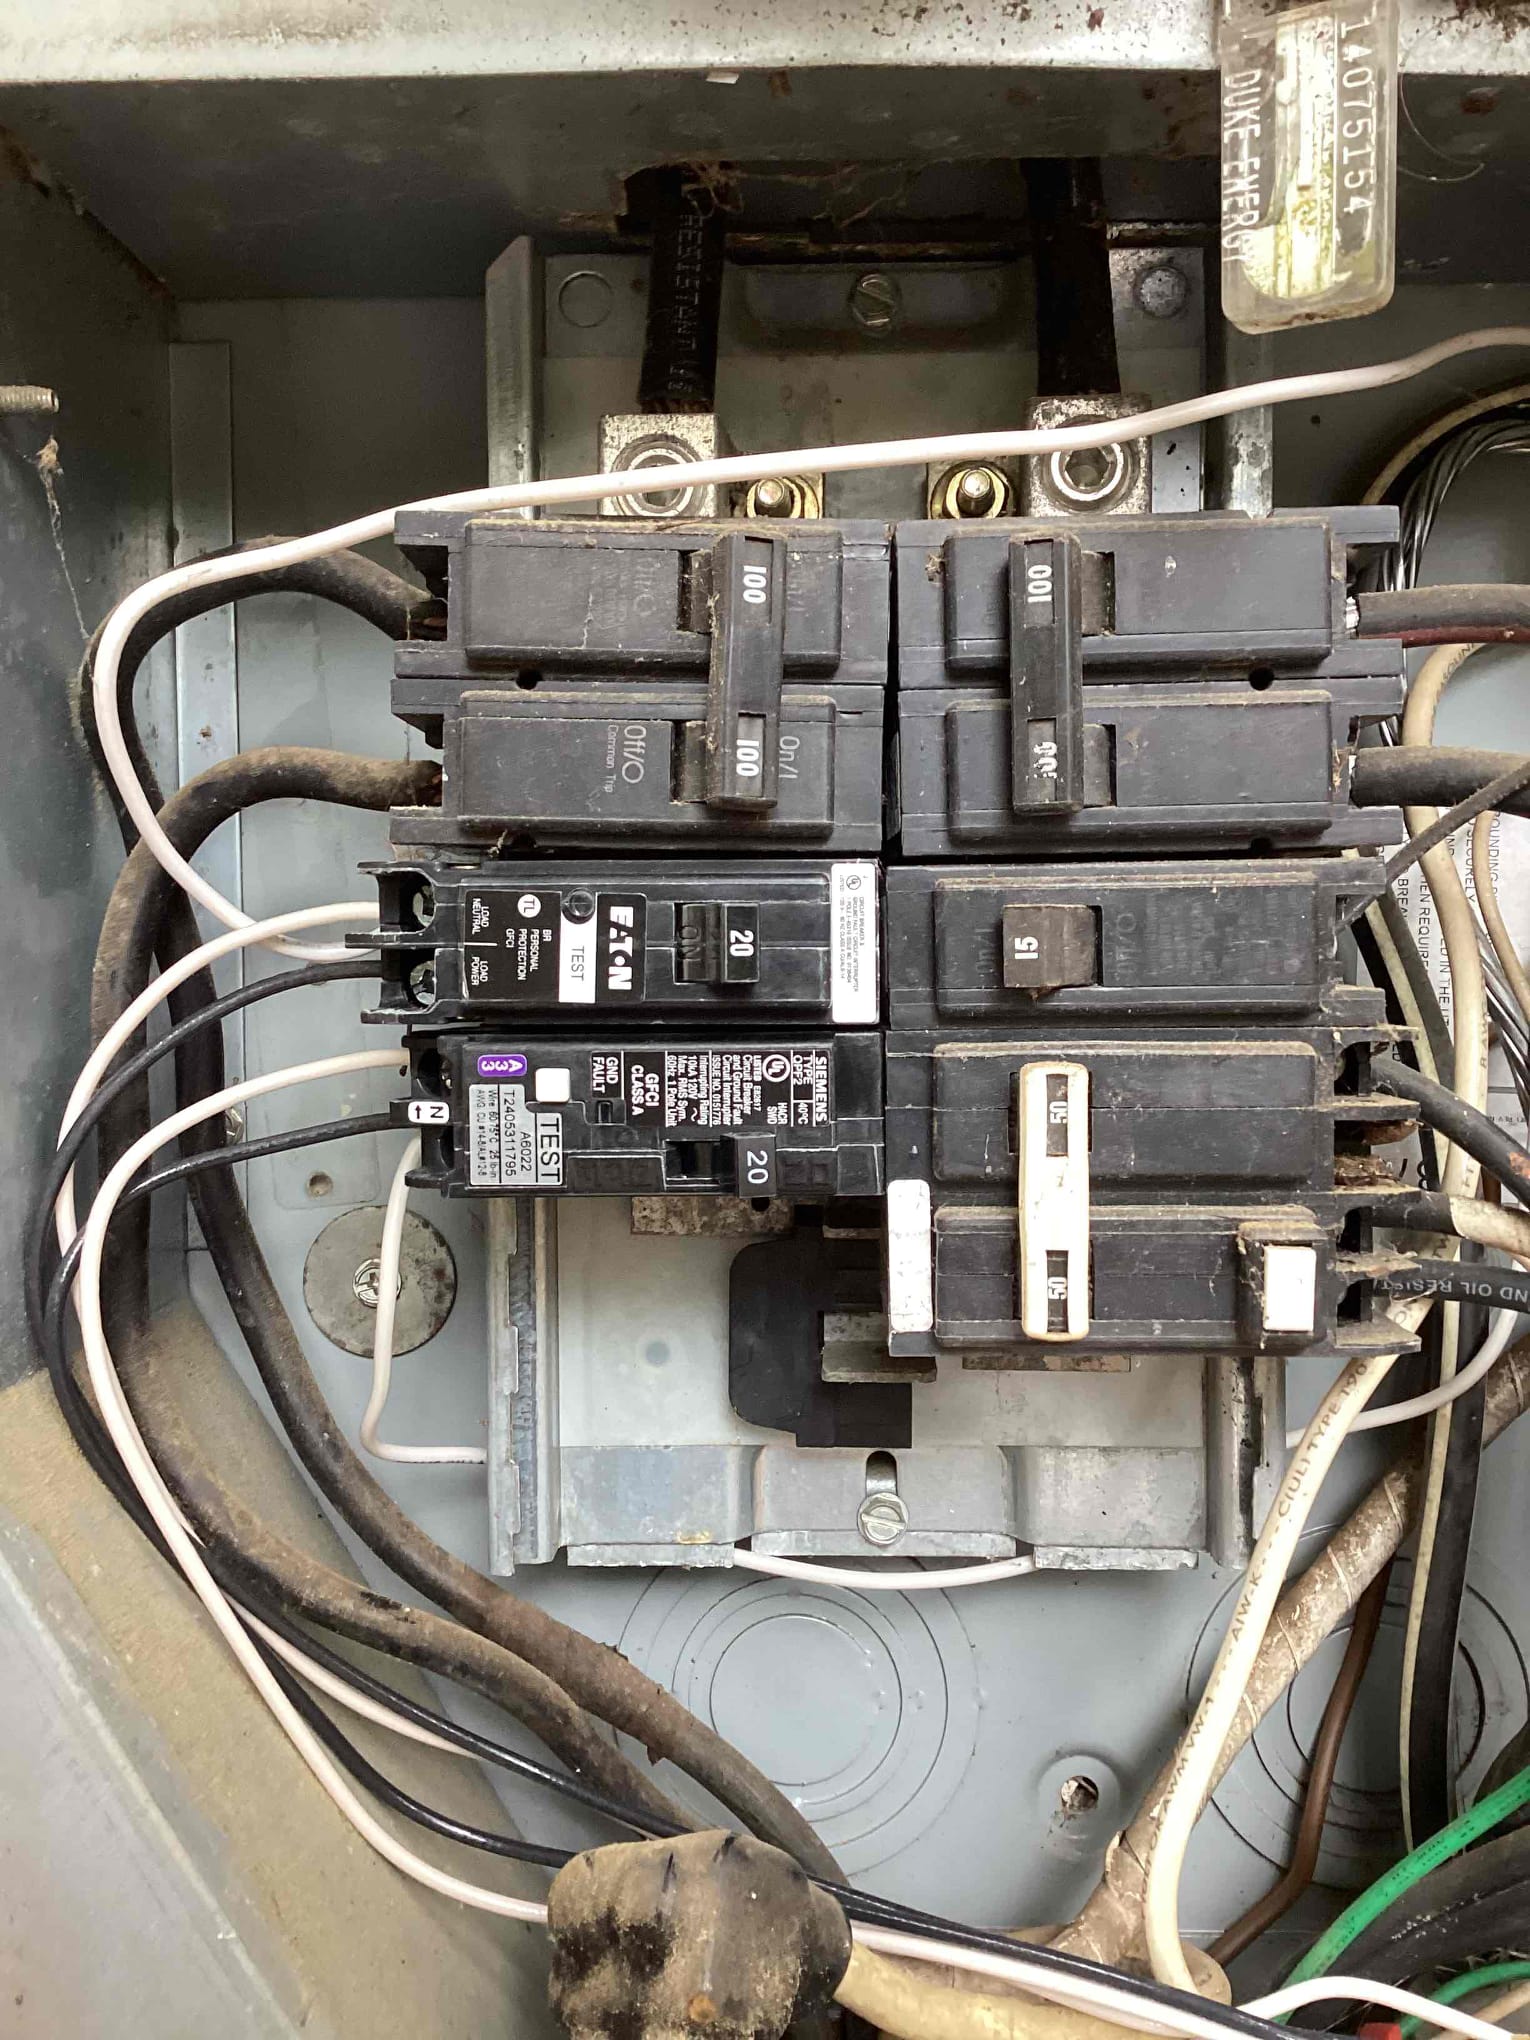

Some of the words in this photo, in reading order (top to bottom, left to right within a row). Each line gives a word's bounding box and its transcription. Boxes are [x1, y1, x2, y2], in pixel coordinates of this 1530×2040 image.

[1223, 70, 1261, 144] DUKE
[1341, 16, 1374, 214] 14075154
[1222, 157, 1260, 263] ENERGY
[742, 564, 767, 604] 100
[1028, 564, 1052, 604] 100
[606, 724, 618, 768] Common
[736, 739, 760, 776] 100
[604, 774, 616, 792] Trip
[472, 898, 480, 934] NEUTRAL
[481, 906, 489, 927] LOAD
[523, 898, 535, 913] TL
[506, 928, 514, 948] GFCI
[543, 929, 552, 942] BR
[730, 930, 754, 957] 20
[1014, 936, 1039, 960] 15
[518, 929, 527, 980] PROTECTION
[530, 929, 540, 972] PERSONAL
[571, 946, 584, 981] TEST
[471, 956, 480, 985] POWER
[480, 960, 488, 982] LOAD
[1439, 978, 1450, 1004] THE
[592, 1057, 605, 1093] FAULT
[606, 1057, 618, 1084] GND
[667, 1055, 677, 1076] 60Hz
[678, 1055, 688, 1076] Max.
[688, 1055, 697, 1076] 10kA
[713, 1054, 721, 1077] ISSUE
[723, 1054, 732, 1081] Circuit
[733, 1054, 742, 1070] and
[743, 1054, 753, 1081] Circuit
[753, 1054, 761, 1081] LISTED
[803, 1055, 812, 1085] TYPE
[631, 1065, 643, 1103] CLASS
[645, 1073, 659, 1106] GFCI
[678, 1078, 688, 1098] RMS
[688, 1078, 697, 1099] 120V
[698, 1055, 709, 1098] Interrupting
[733, 1072, 742, 1102] Ground
[815, 1056, 827, 1122] SIEMENS
[632, 1106, 643, 1115] A
[667, 1088, 677, 1107] Pole
[676, 1100, 688, 1122] Sym.
[721, 1082, 732, 1125] Interrupter
[743, 1082, 753, 1114] Breaker
[430, 1106, 444, 1118] N
[667, 1109, 677, 1126] Unit
[698, 1100, 709, 1125] Rating
[733, 1104, 743, 1125] Fault
[767, 1106, 776, 1124] SWD
[778, 1102, 787, 1124] HACR
[1050, 1100, 1068, 1124] 50
[503, 1090, 516, 1176] T2405311795
[520, 1132, 532, 1172] A6022
[540, 1117, 560, 1182] TEST
[747, 1150, 768, 1184] 20
[1048, 1276, 1068, 1300] 50
[1374, 1279, 1452, 1293] RESIST
[1460, 1281, 1492, 1297] OIL
[1308, 1406, 1342, 1451] TYPE
